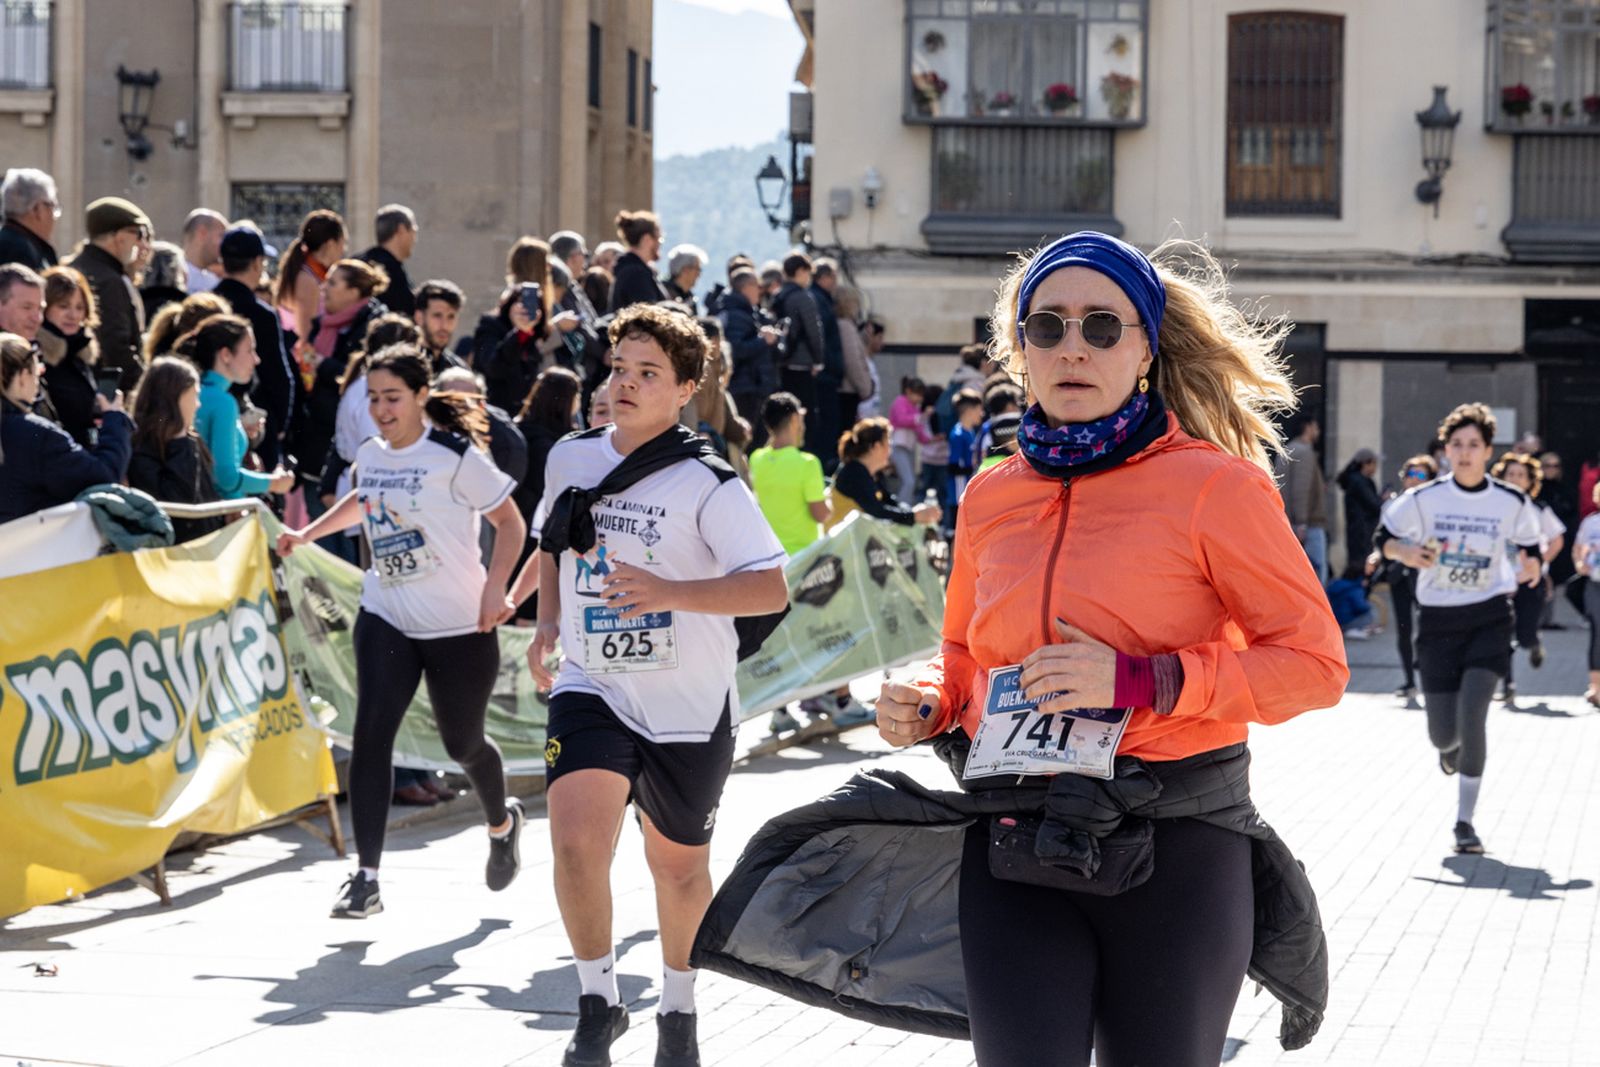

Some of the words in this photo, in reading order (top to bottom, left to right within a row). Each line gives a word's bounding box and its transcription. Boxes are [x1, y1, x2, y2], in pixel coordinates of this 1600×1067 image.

[615, 500, 666, 518] CAMINATA
[594, 512, 639, 536] MUERTE
[384, 552, 417, 576] 593
[1449, 567, 1479, 584] 669
[602, 631, 653, 659] 625
[1001, 711, 1076, 751] 741
